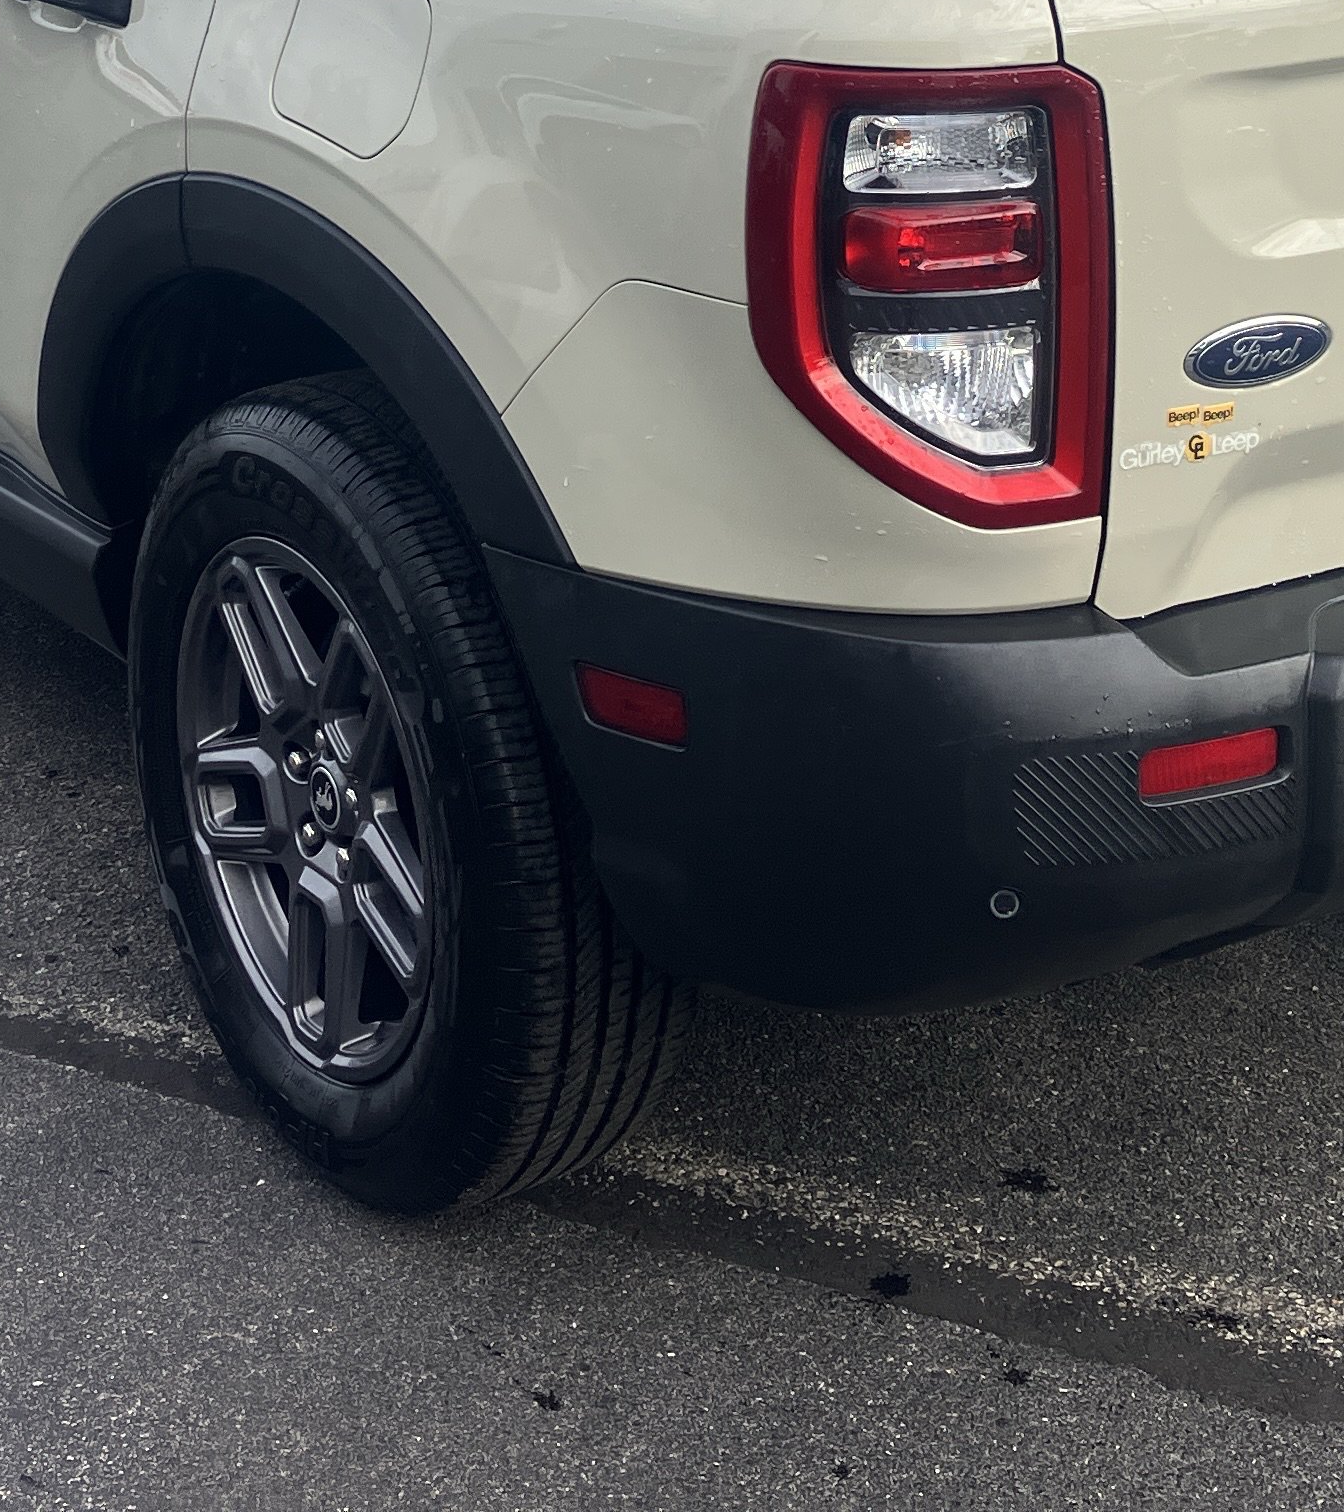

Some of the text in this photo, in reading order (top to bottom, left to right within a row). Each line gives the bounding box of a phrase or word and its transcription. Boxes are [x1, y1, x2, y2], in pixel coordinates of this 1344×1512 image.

[1223, 332, 1303, 376] Ford
[1168, 406, 1234, 423] Beep! Beep!
